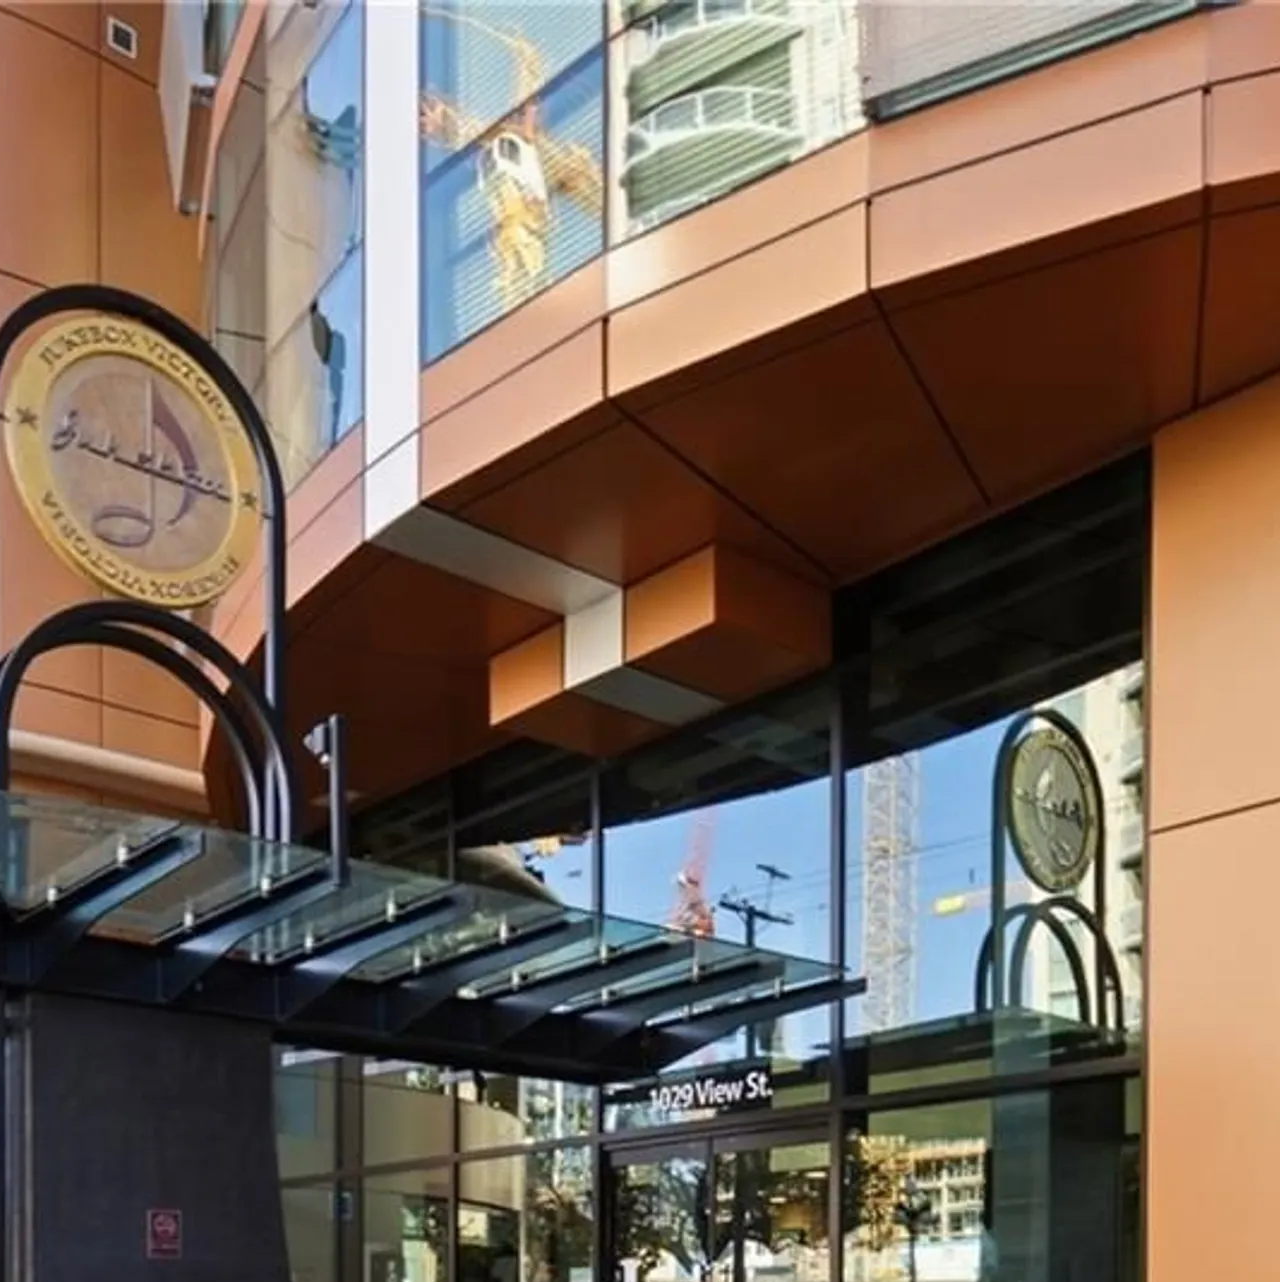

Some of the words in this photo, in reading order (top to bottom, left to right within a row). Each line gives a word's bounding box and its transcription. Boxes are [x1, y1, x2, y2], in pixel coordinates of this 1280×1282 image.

[649, 1083, 694, 1110] 1029
[695, 1079, 743, 1105] View
[746, 1071, 773, 1099] St.
